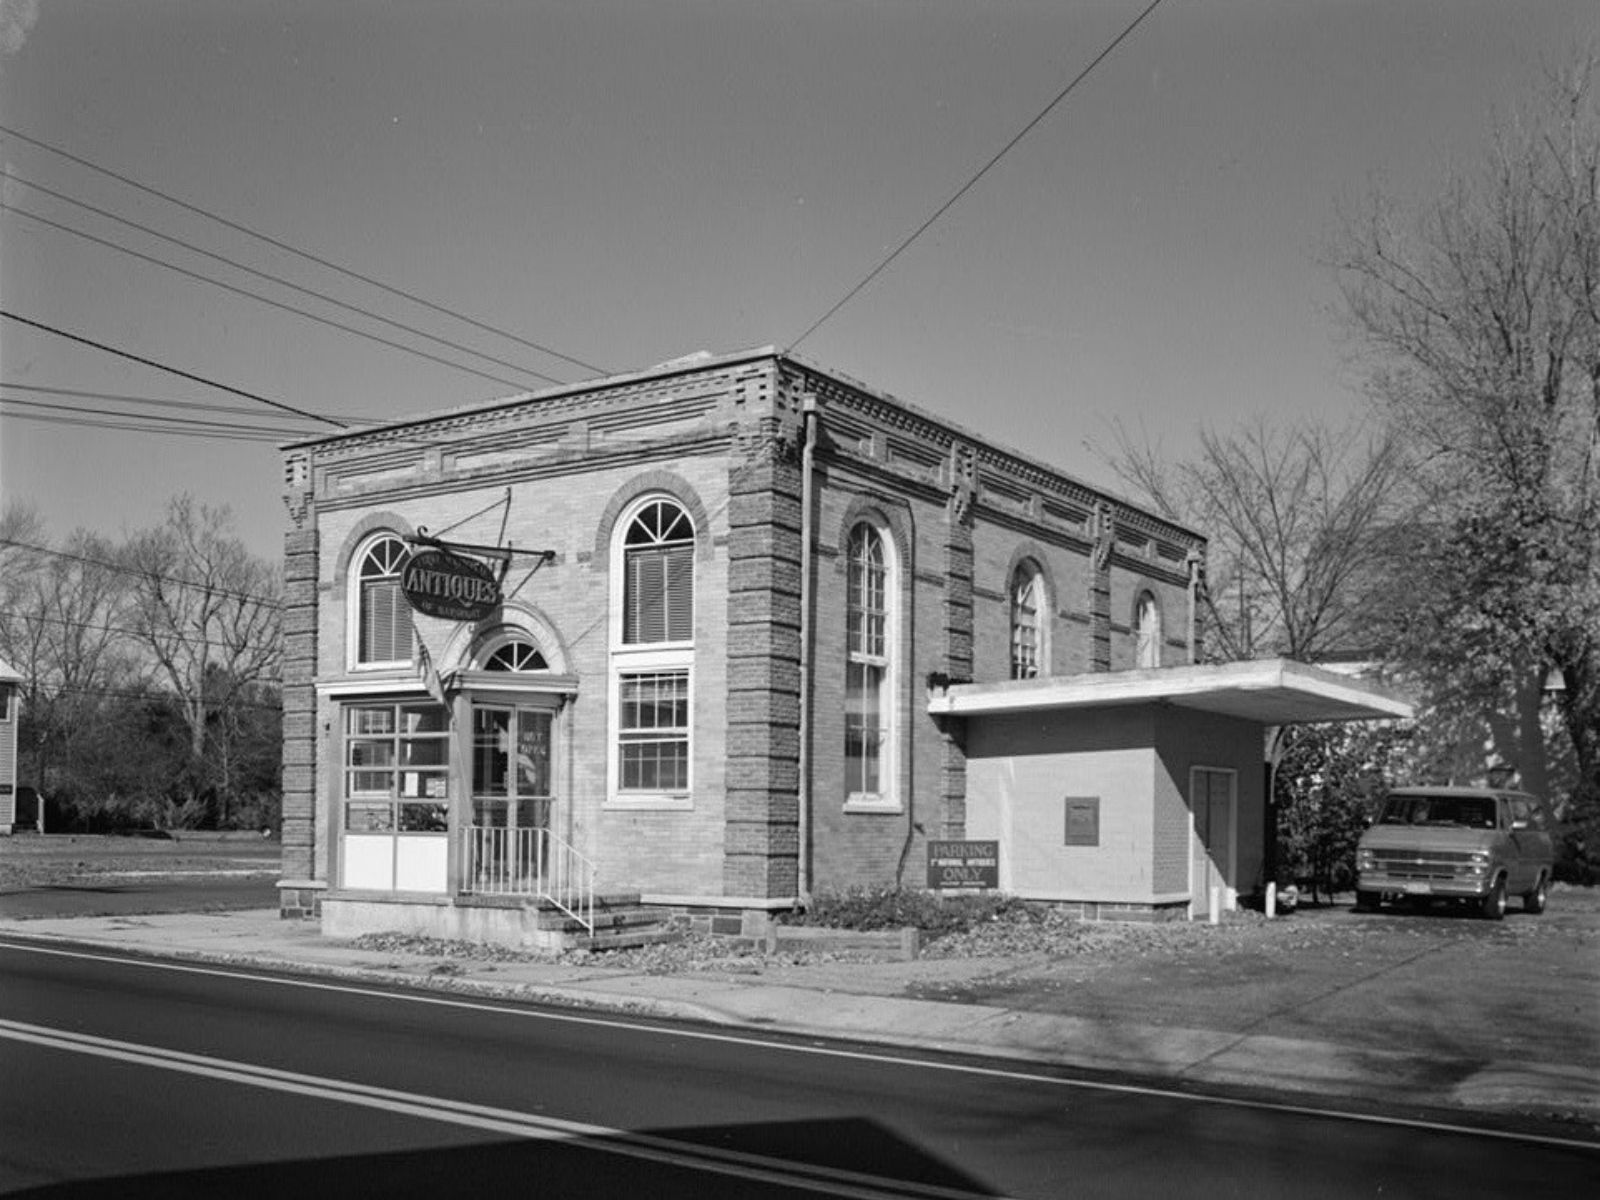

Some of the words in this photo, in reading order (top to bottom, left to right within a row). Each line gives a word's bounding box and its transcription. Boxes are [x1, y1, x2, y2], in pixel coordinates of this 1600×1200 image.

[406, 567, 498, 607] ANTIQUES
[934, 844, 993, 857] PARKING
[942, 867, 982, 881] ONLY
